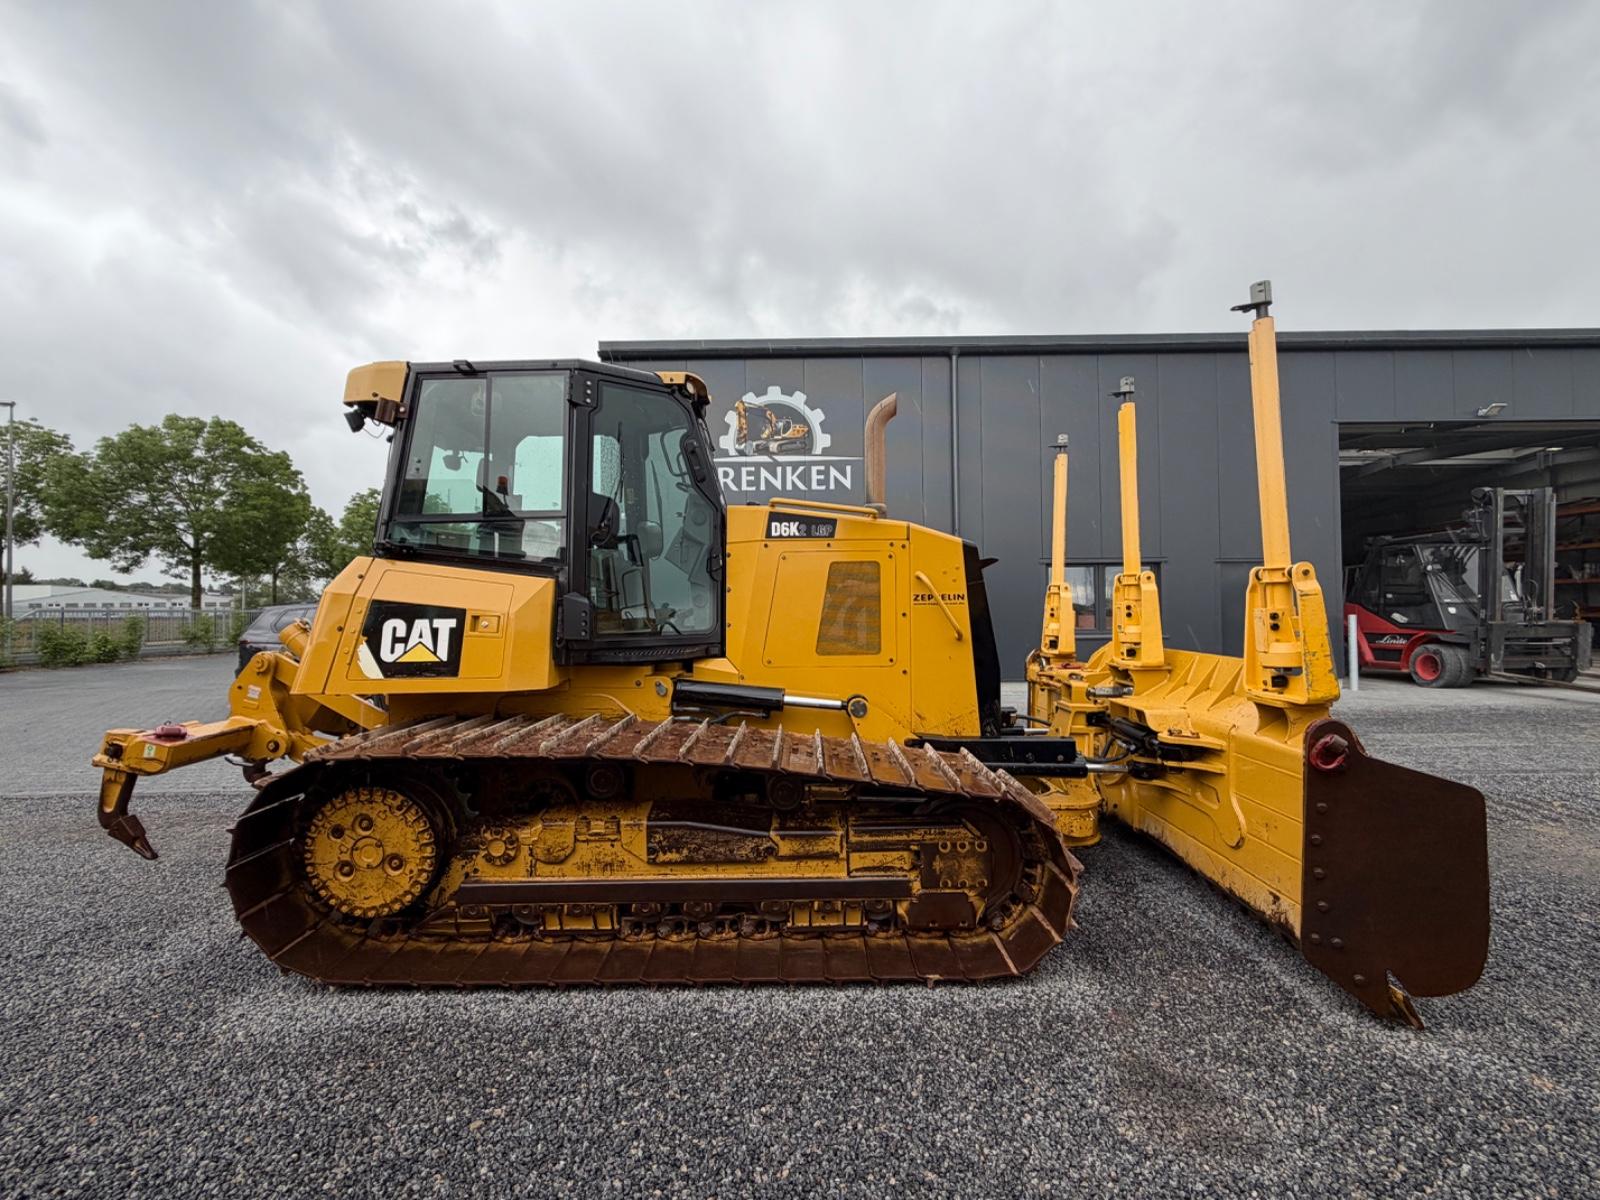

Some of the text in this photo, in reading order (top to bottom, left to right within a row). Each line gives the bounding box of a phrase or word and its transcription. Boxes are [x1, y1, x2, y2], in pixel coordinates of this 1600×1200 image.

[717, 465, 852, 491] RENKEN
[912, 593, 966, 602] ZEPELIN
[380, 618, 457, 663] CAT
